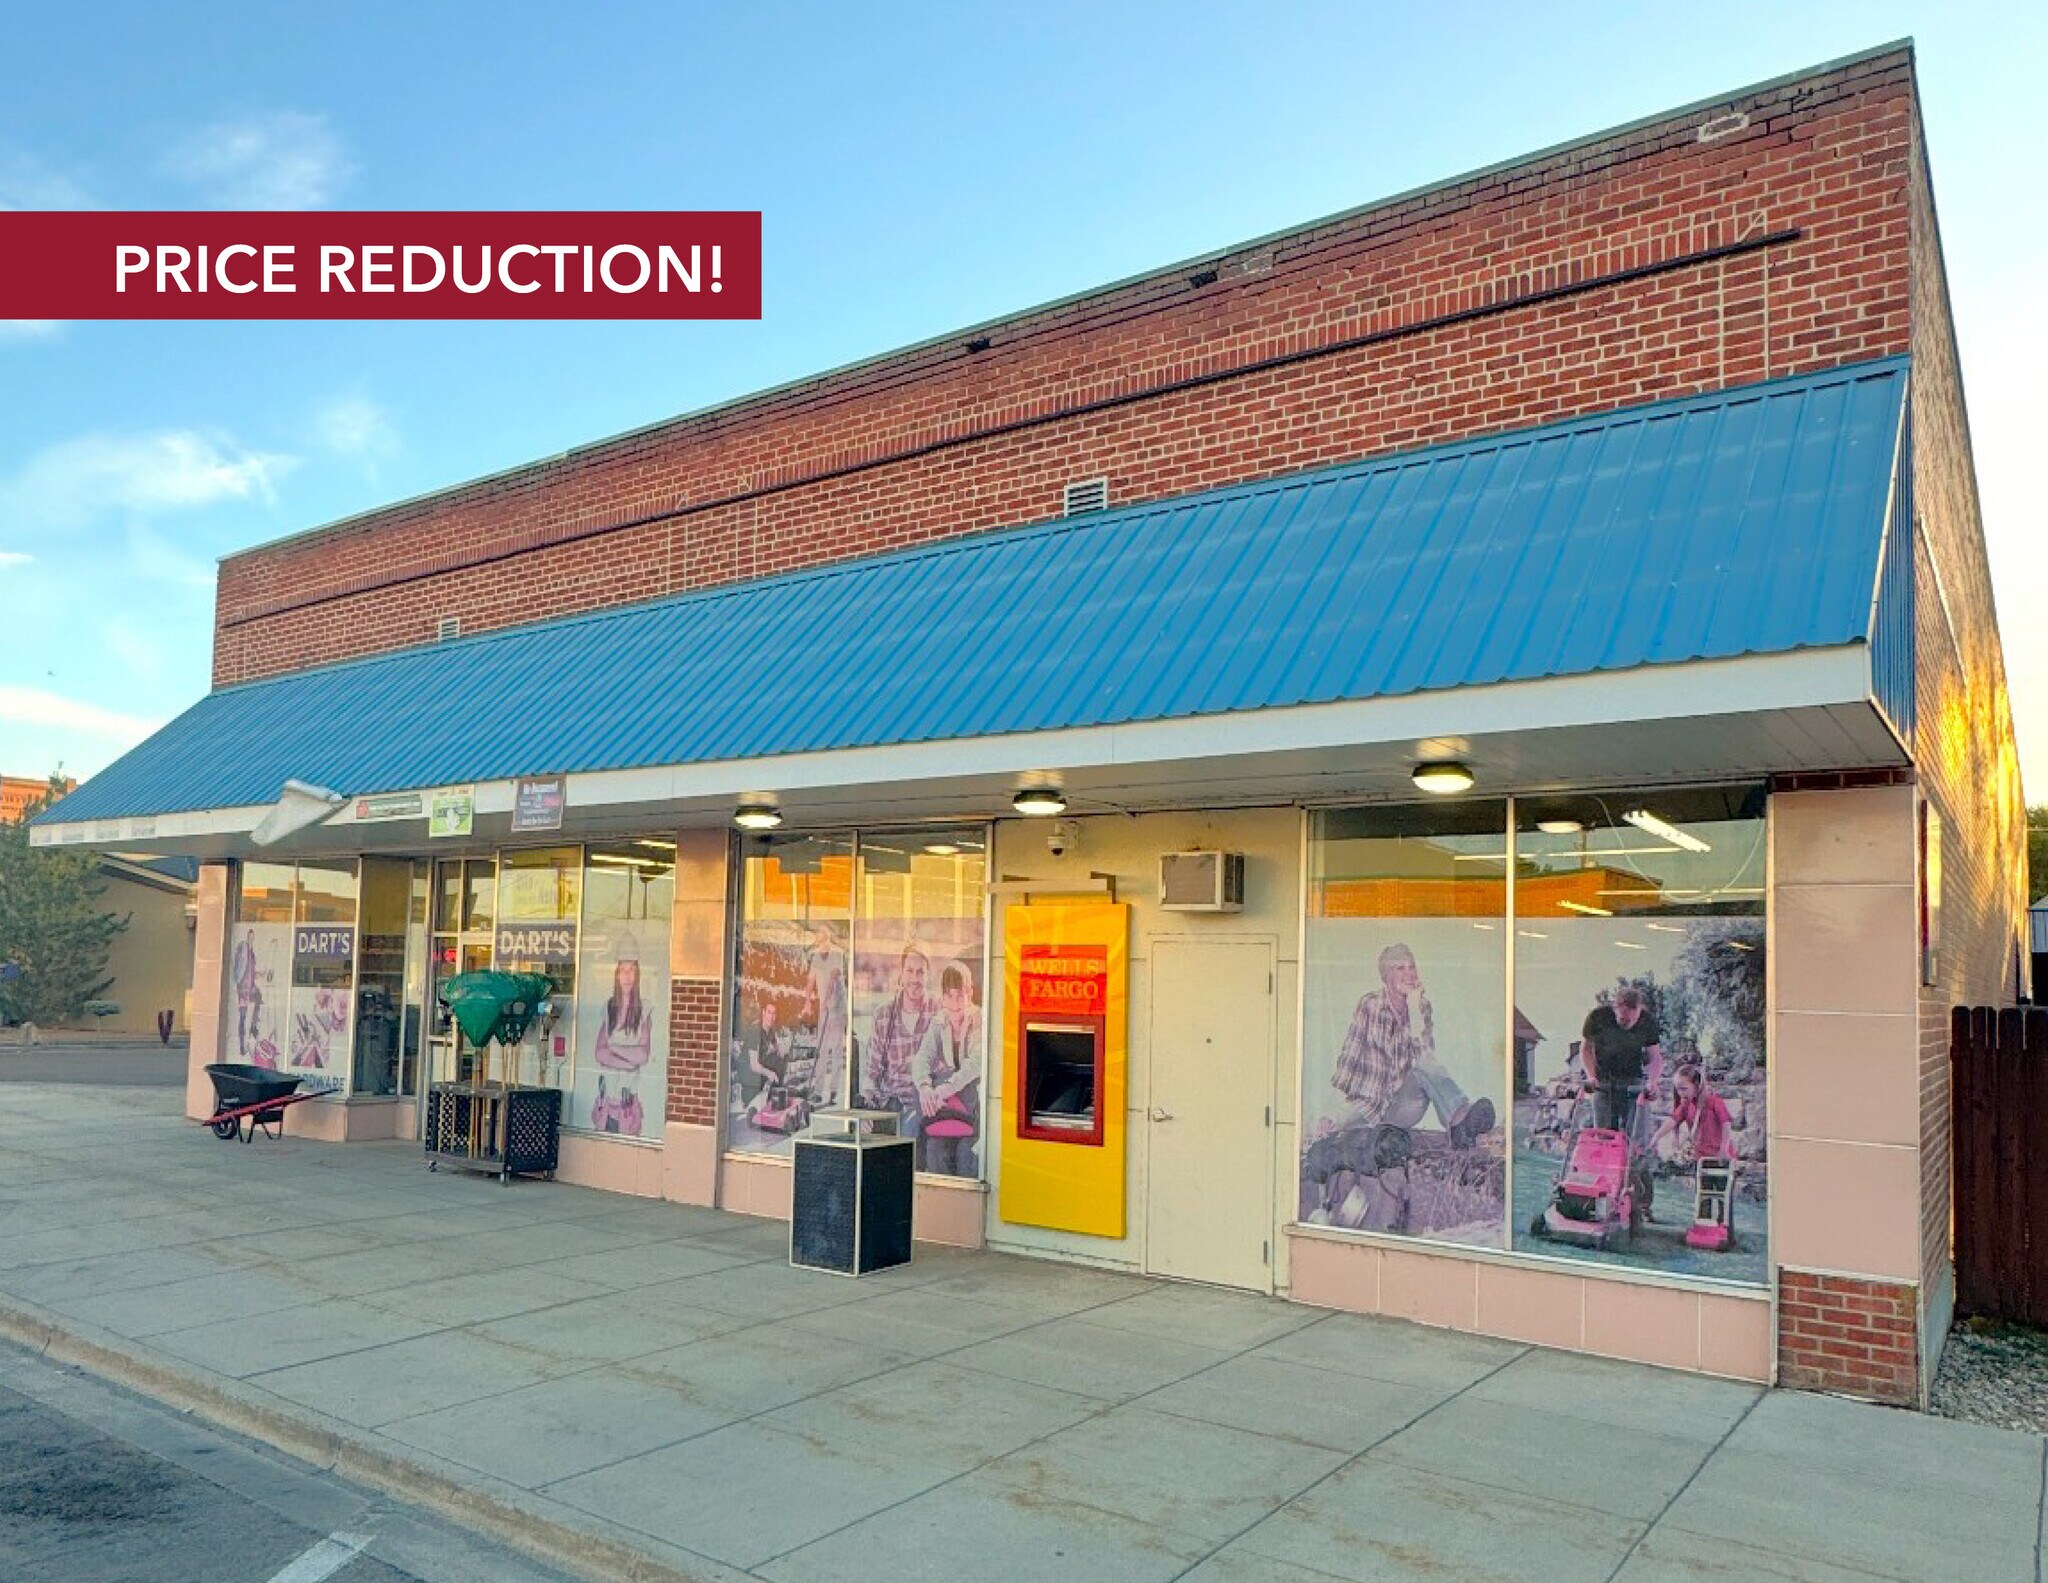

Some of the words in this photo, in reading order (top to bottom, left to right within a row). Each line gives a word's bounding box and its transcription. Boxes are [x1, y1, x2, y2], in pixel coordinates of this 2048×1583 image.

[299, 932, 350, 955] DART'S
[500, 930, 569, 956] DART'S
[1029, 959, 1098, 976] WELLS
[1029, 979, 1099, 999] FARGO
